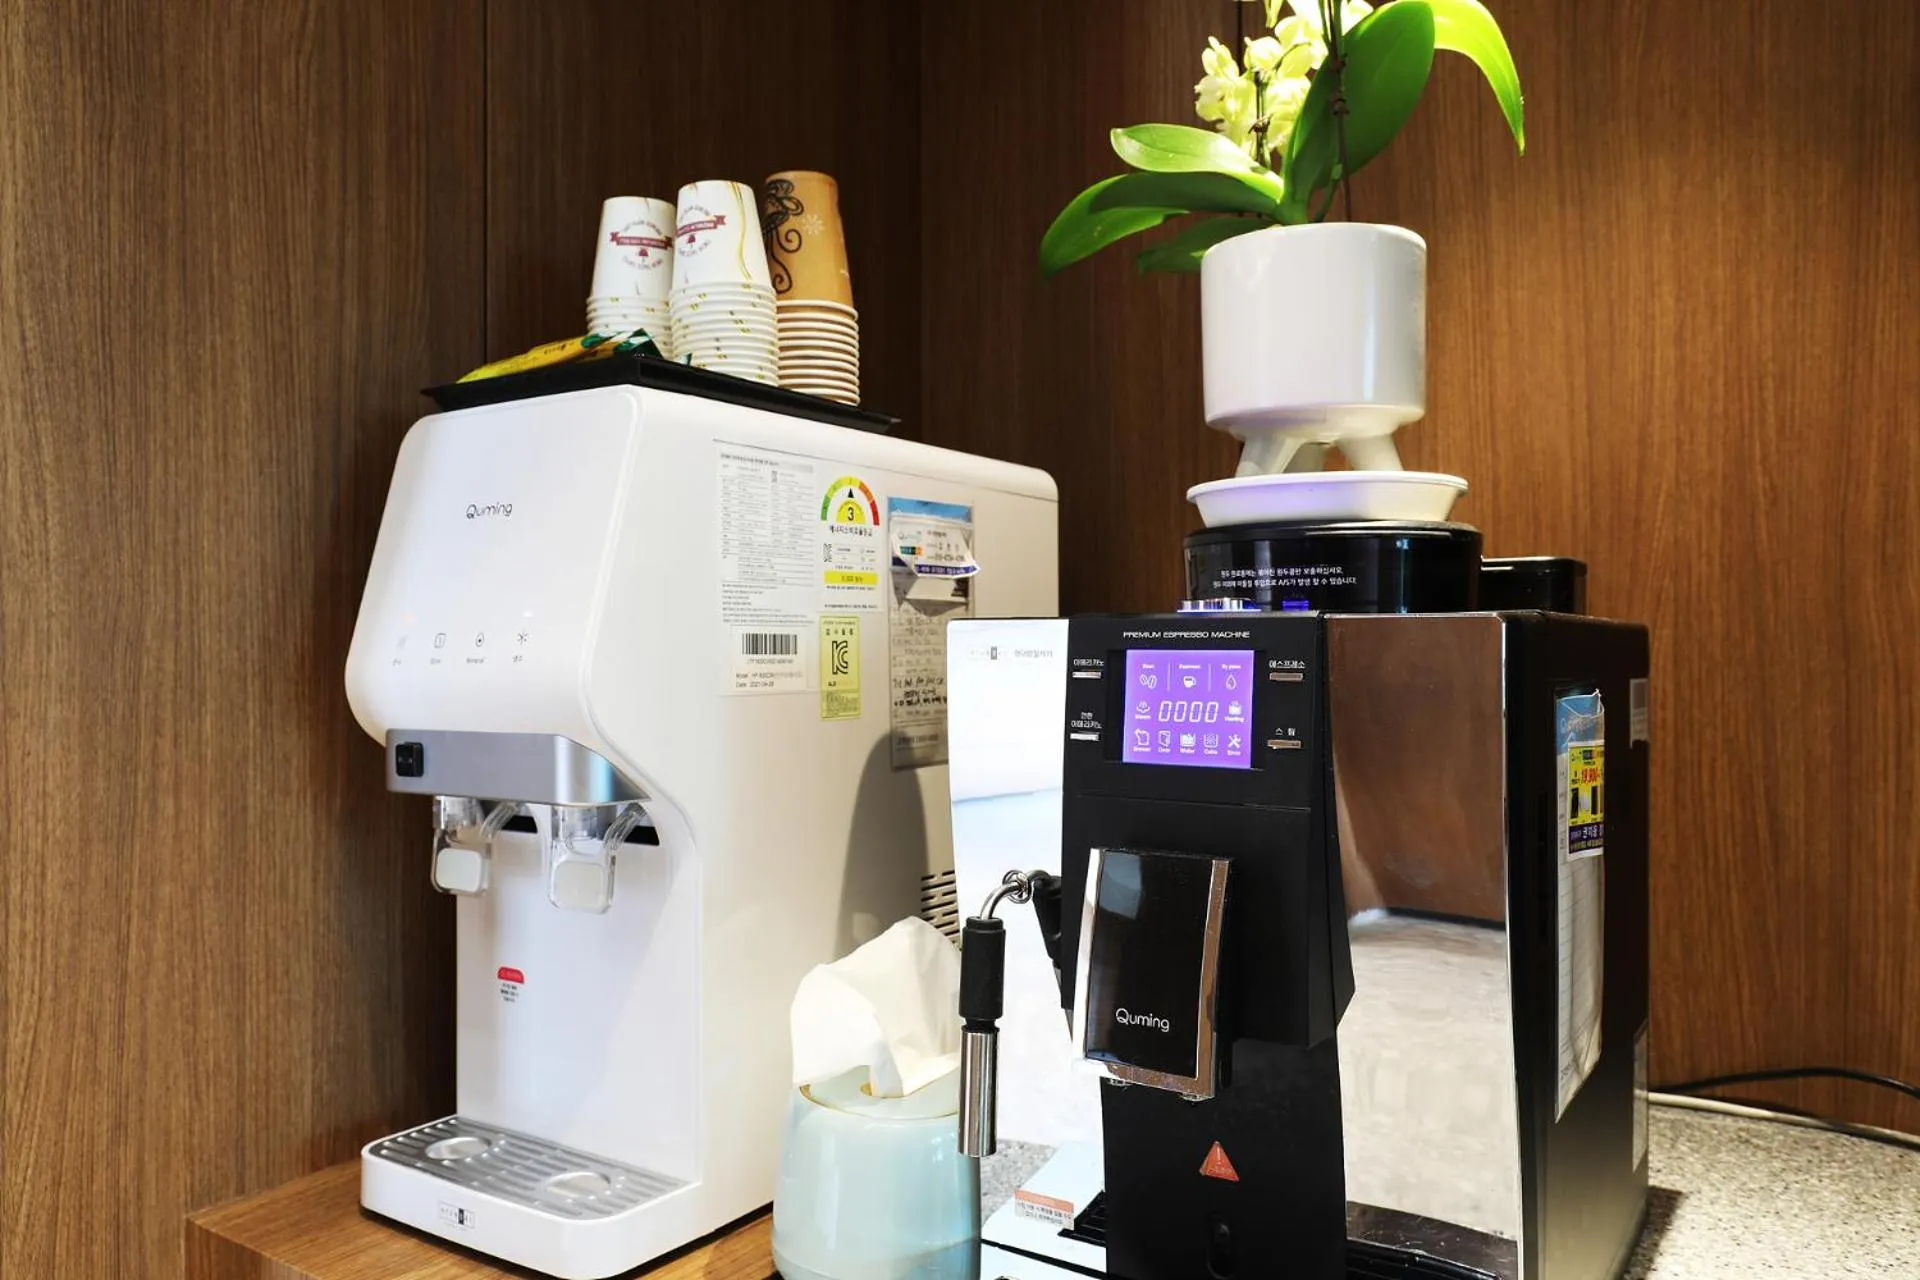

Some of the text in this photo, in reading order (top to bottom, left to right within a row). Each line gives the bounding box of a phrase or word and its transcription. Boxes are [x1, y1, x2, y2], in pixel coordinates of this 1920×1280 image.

[466, 503, 513, 519] Quming
[847, 506, 855, 521] 3
[1123, 631, 1250, 639] PREMIUM ESPRESSO MACHINE
[1269, 660, 1305, 669] 에스프레소
[1158, 700, 1219, 723] 0000
[1116, 1007, 1170, 1032] Quming
